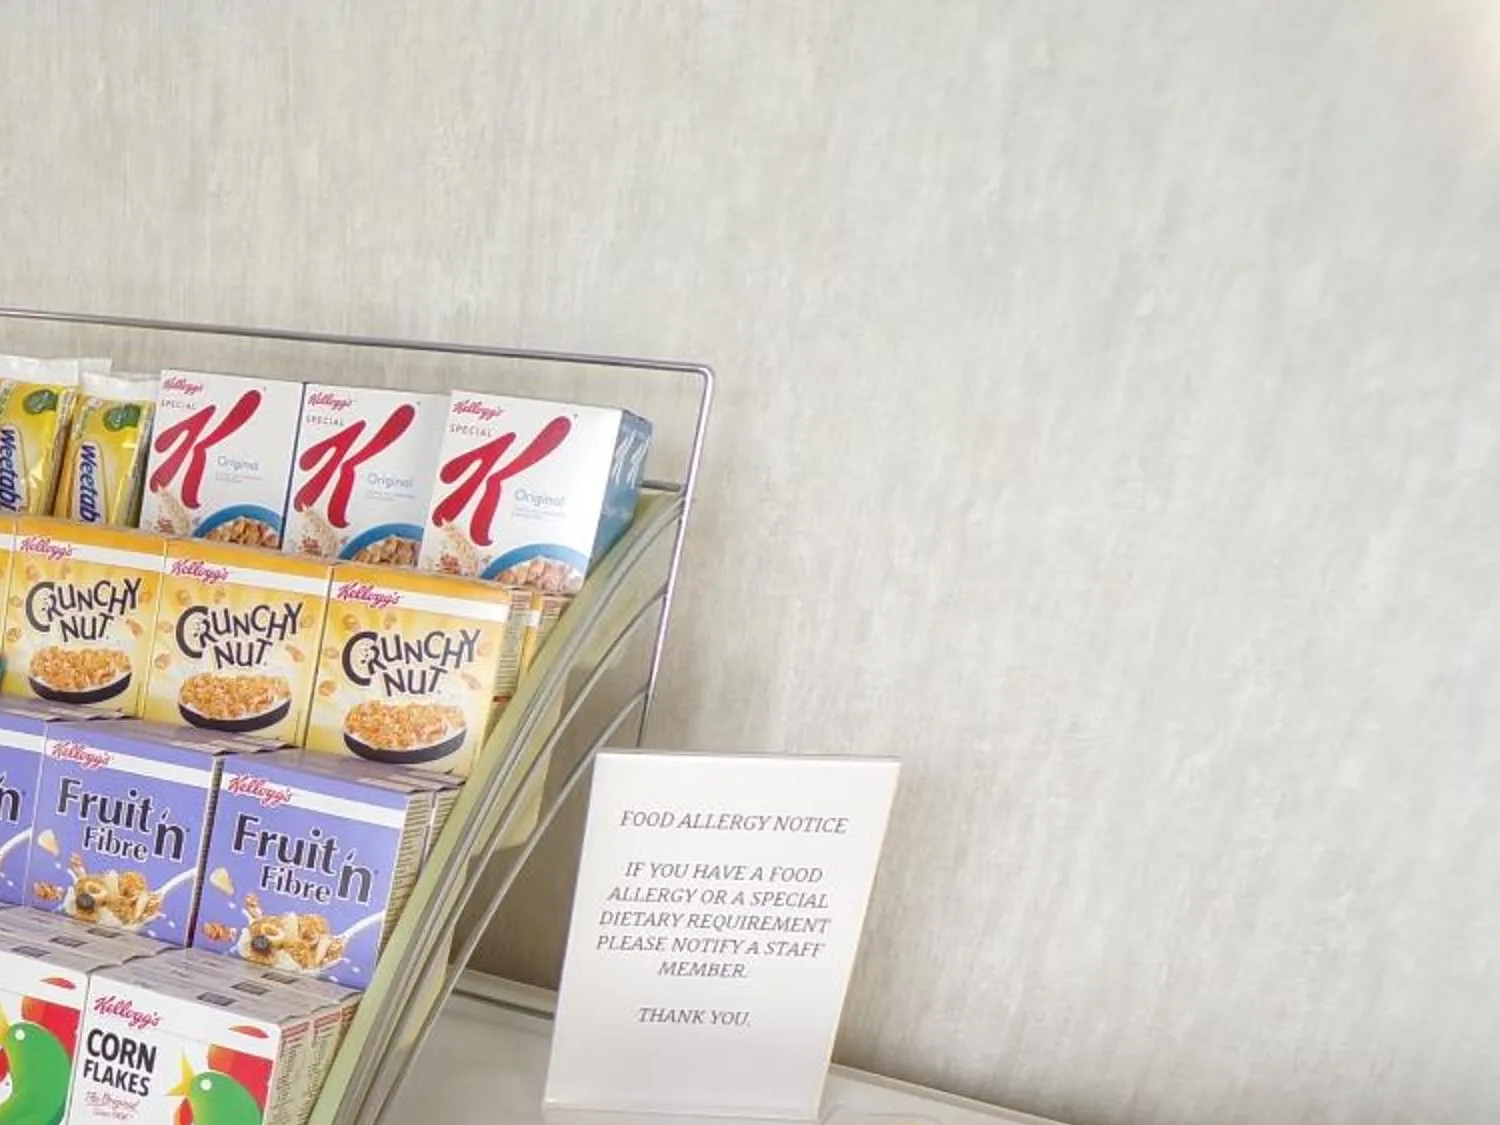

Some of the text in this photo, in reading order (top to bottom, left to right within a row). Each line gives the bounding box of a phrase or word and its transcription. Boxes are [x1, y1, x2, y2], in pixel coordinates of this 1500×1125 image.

[161, 400, 197, 411] SPECIAL
[306, 415, 344, 427] SPECIAL
[450, 423, 493, 437] SPECIAL
[150, 389, 262, 509] K
[0, 428, 21, 513] Weetabi
[294, 404, 415, 528] K
[432, 416, 572, 546] K
[80, 444, 102, 523] Weetab
[20, 535, 76, 560] Kellogg's
[171, 559, 230, 585] Kellogg's
[25, 576, 143, 632] CRUNCHY
[336, 580, 401, 606] Kellogg's
[60, 612, 115, 642] NUT
[175, 602, 303, 658] CRUNCHY
[213, 638, 274, 669] NUT
[342, 628, 481, 686] CRUNCHY
[382, 665, 448, 696] NUT
[52, 739, 111, 768] Kellogg's
[56, 776, 153, 833] Fruit
[228, 773, 293, 808] Kellogg's
[620, 810, 849, 834] FOOD ALLERGY NOTICE
[83, 826, 148, 862] Fibre
[232, 812, 338, 875] Fruit
[260, 865, 332, 904] Fibre
[624, 862, 823, 884] IF YOU HAVE A FOOD
[607, 887, 829, 909] ALLERGY OR A SPECIAL
[599, 911, 831, 934] DIETARY REQUIREMENT
[596, 936, 826, 958] PLEASE NOTIFY A STAFF
[94, 995, 162, 1029] Kellogg's
[638, 1007, 752, 1027] THANK YOU.
[87, 1028, 157, 1074] CORN
[83, 1059, 150, 1097] FLAKES
